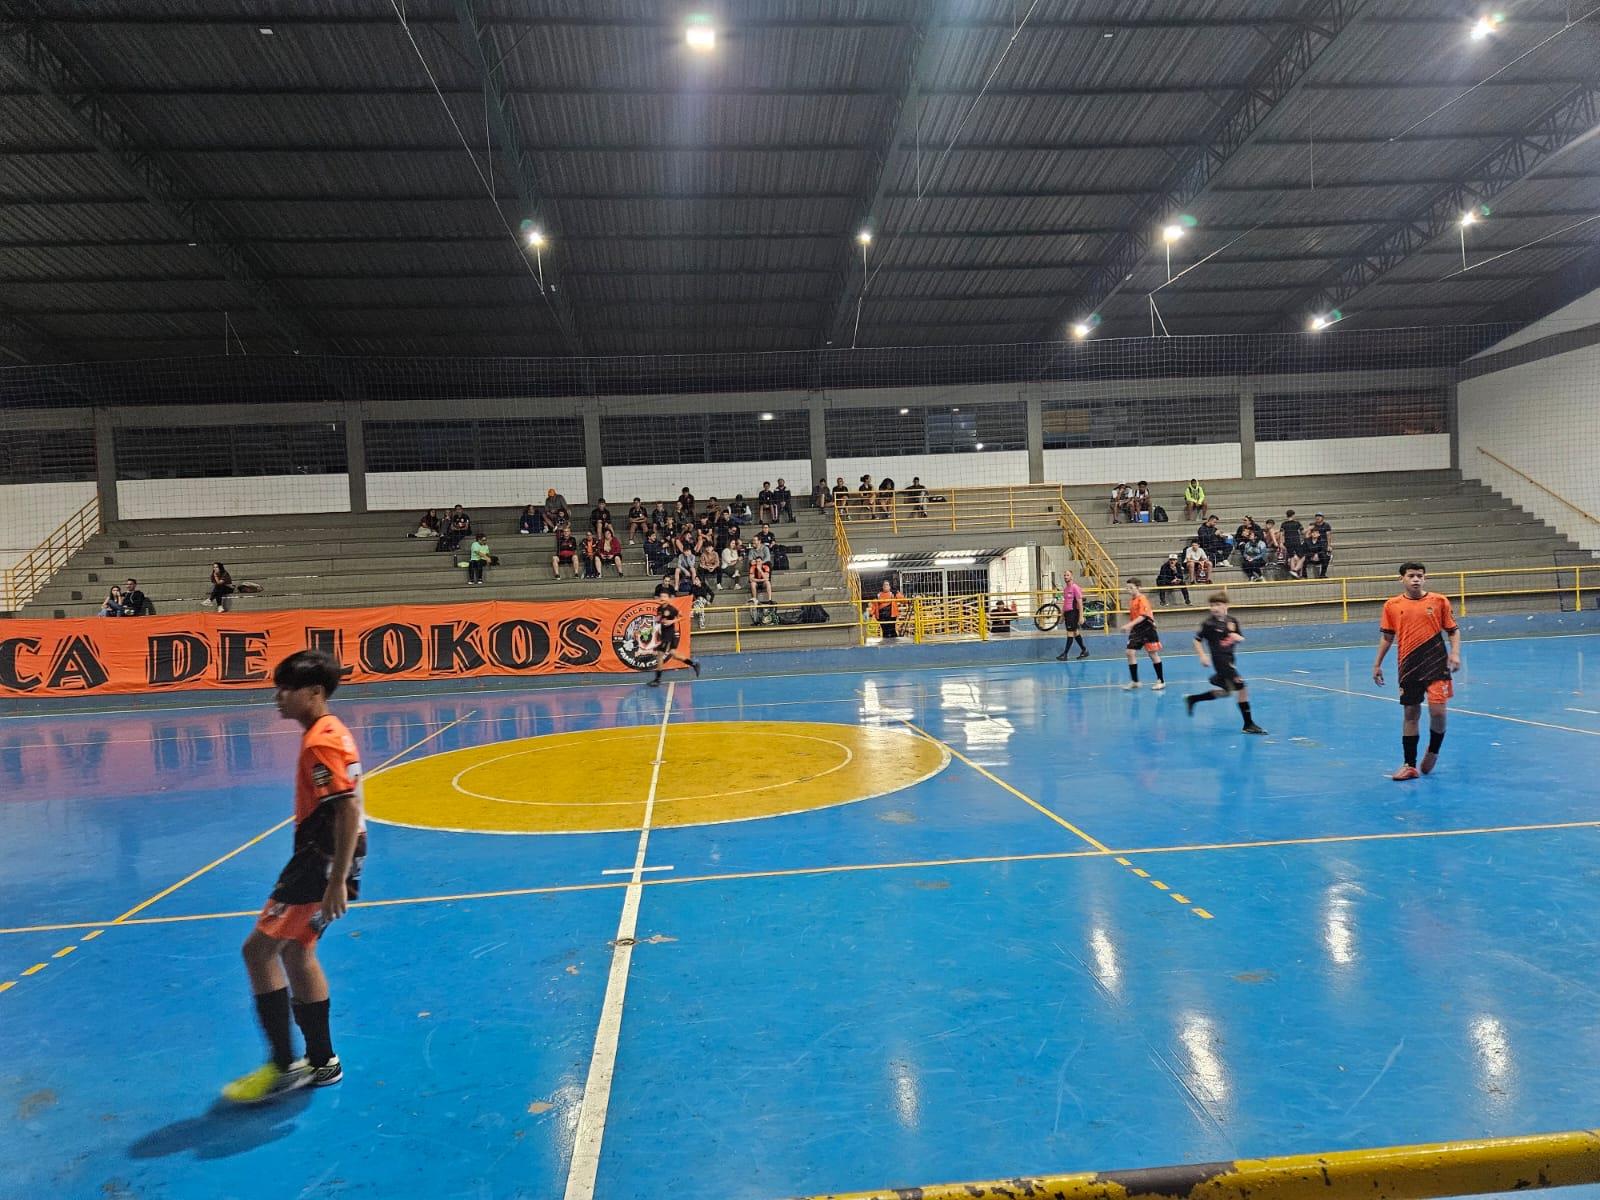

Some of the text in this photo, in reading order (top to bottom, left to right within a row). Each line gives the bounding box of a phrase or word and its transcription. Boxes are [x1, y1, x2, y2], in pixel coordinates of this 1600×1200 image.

[0, 616, 602, 691] CA DE LOKOS
